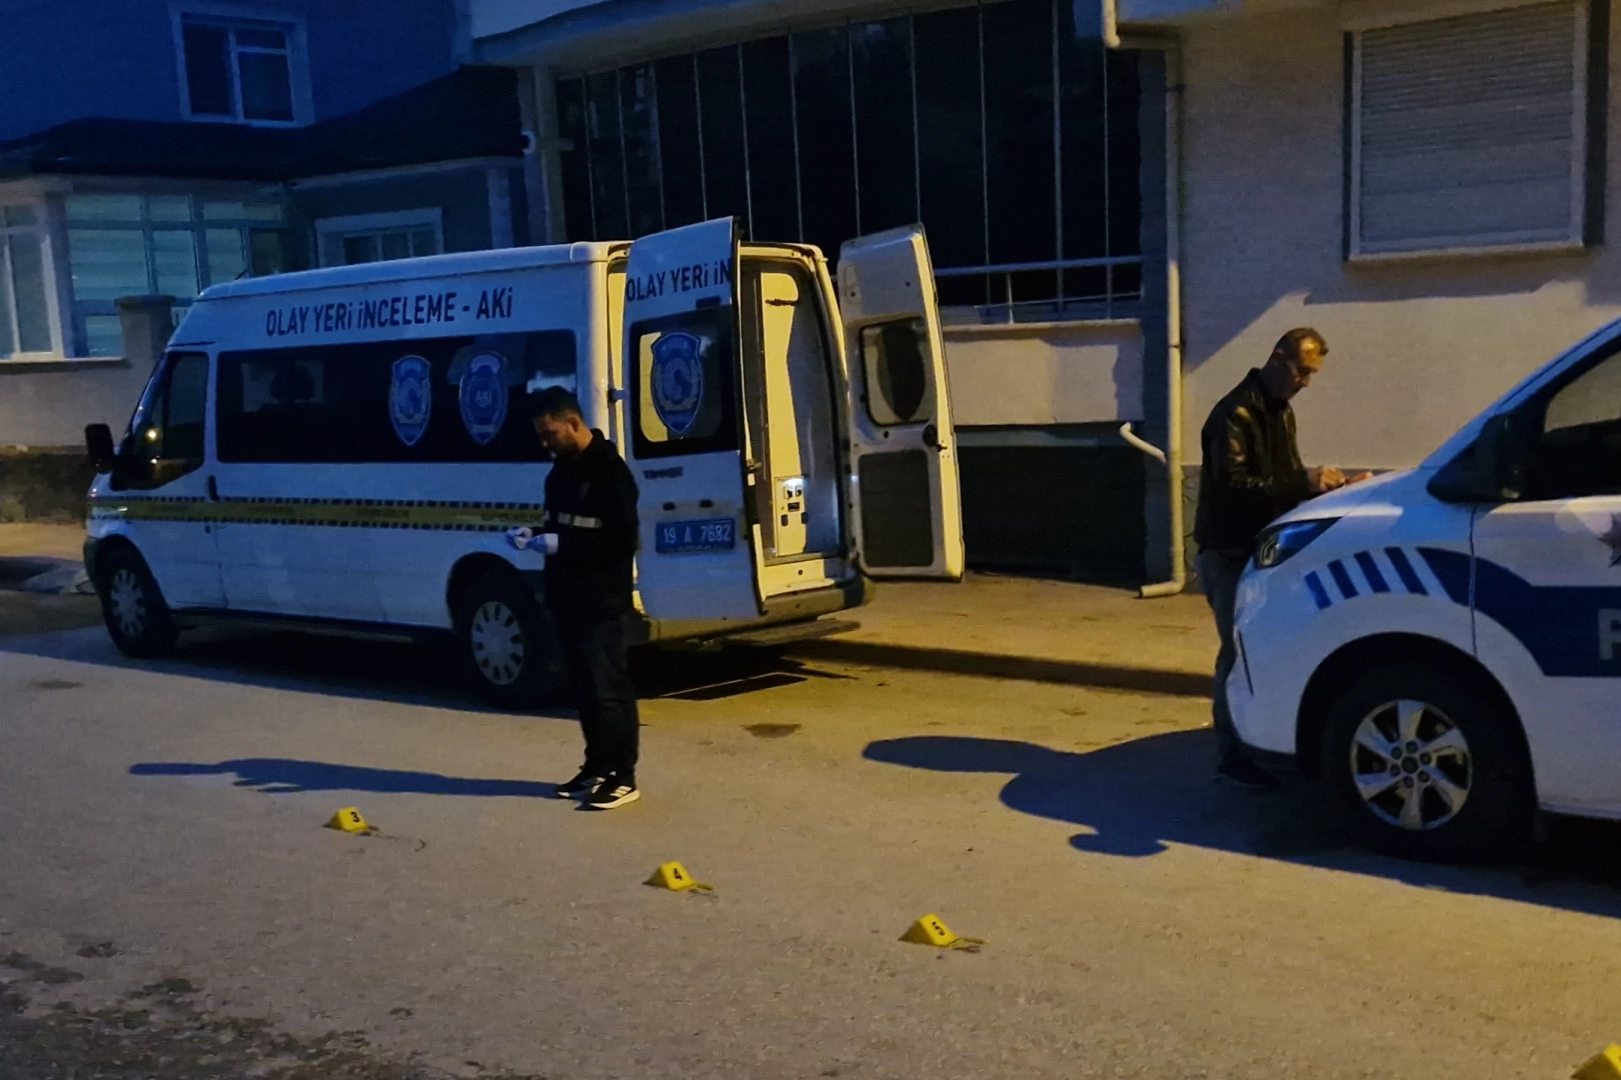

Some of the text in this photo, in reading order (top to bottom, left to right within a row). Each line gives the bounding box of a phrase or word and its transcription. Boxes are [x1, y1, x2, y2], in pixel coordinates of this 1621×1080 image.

[626, 271, 666, 302] OLAY
[266, 306, 309, 337] OLAY
[351, 811, 361, 823] 3
